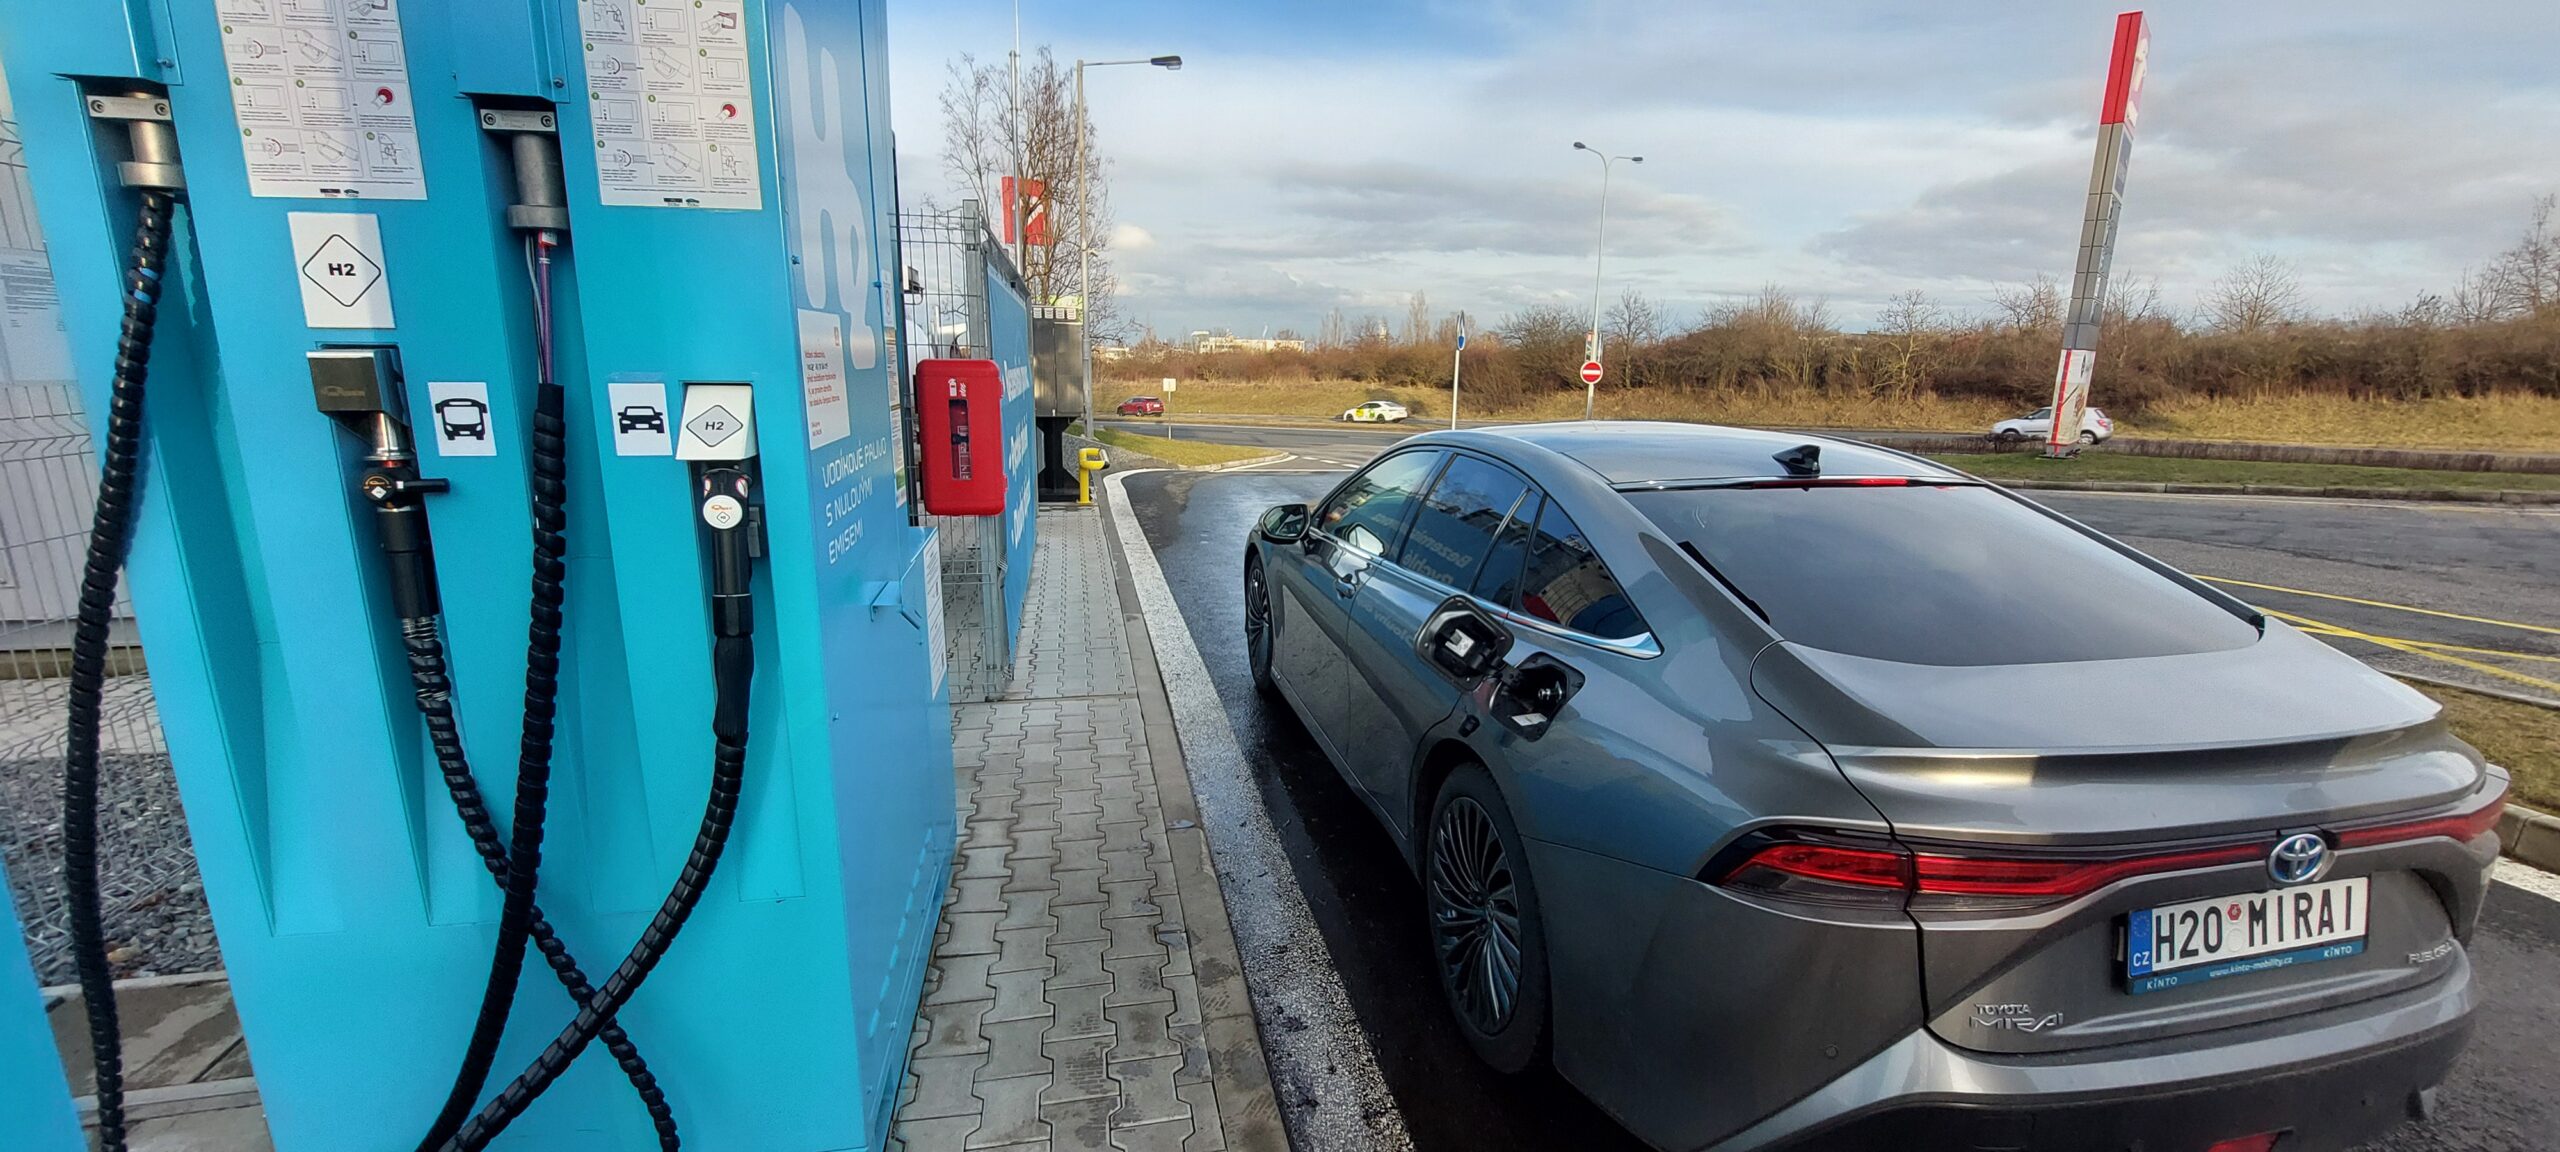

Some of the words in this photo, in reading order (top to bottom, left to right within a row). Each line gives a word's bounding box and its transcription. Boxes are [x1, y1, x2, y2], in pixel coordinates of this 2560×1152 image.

[328, 263, 356, 276] H2
[705, 421, 724, 431] H2
[864, 437, 886, 464] PALIVO
[826, 503, 833, 527] S
[828, 517, 864, 564] EMISEMI
[2249, 886, 2352, 947] MIRAI
[2133, 950, 2150, 967] CZ
[2209, 957, 2293, 977] www.kinto-mobility.cz
[1974, 1003, 2031, 1015] TOYOTA
[1969, 1012, 2063, 1032] MIRAI
